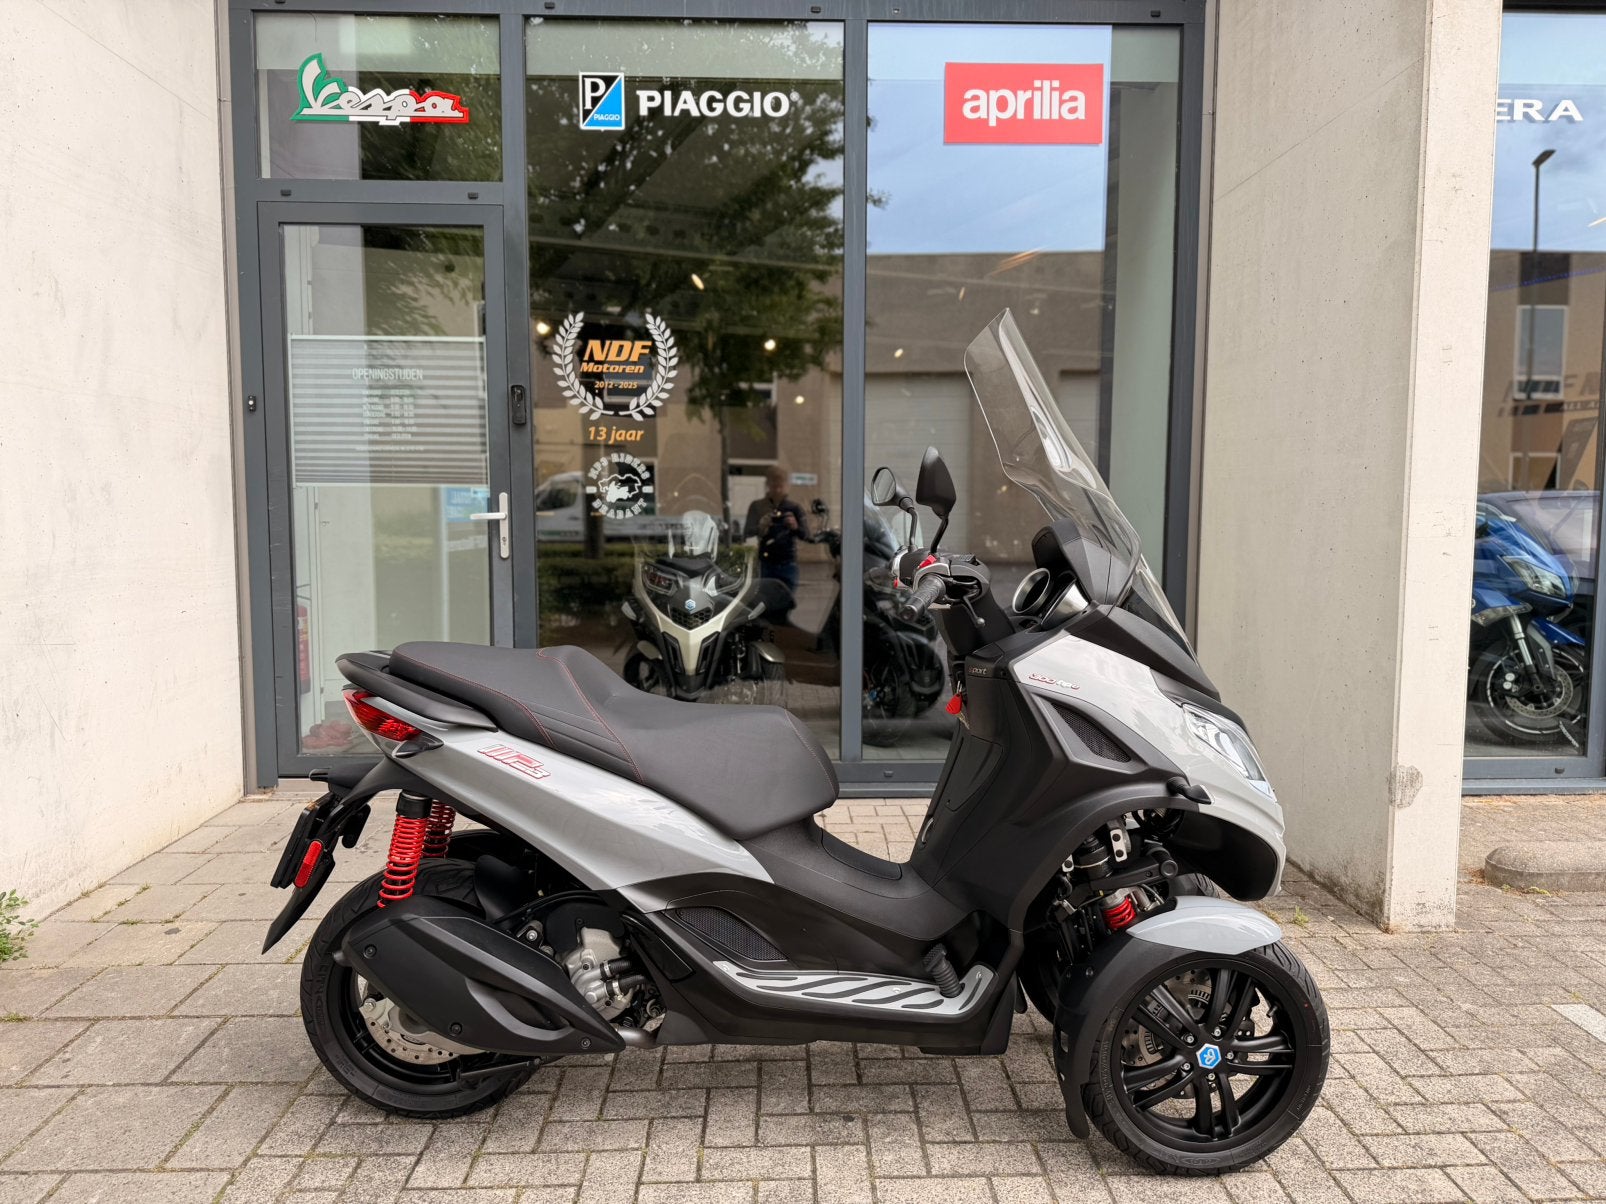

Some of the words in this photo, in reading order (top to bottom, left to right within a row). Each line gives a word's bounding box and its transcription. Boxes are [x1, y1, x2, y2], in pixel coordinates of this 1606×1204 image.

[299, 58, 464, 121] Vespa
[584, 77, 606, 109] P
[962, 80, 1086, 126] aprilia
[593, 113, 621, 121] PIAGGIO
[583, 339, 653, 362] NDF
[352, 367, 424, 380] OPENINGSTIJDEN
[579, 362, 645, 374] Motoren
[594, 381, 614, 389] 2012
[618, 381, 638, 389] 2025
[588, 426, 607, 441] 13
[608, 426, 645, 445] jaar
[611, 452, 651, 480] RIDERS
